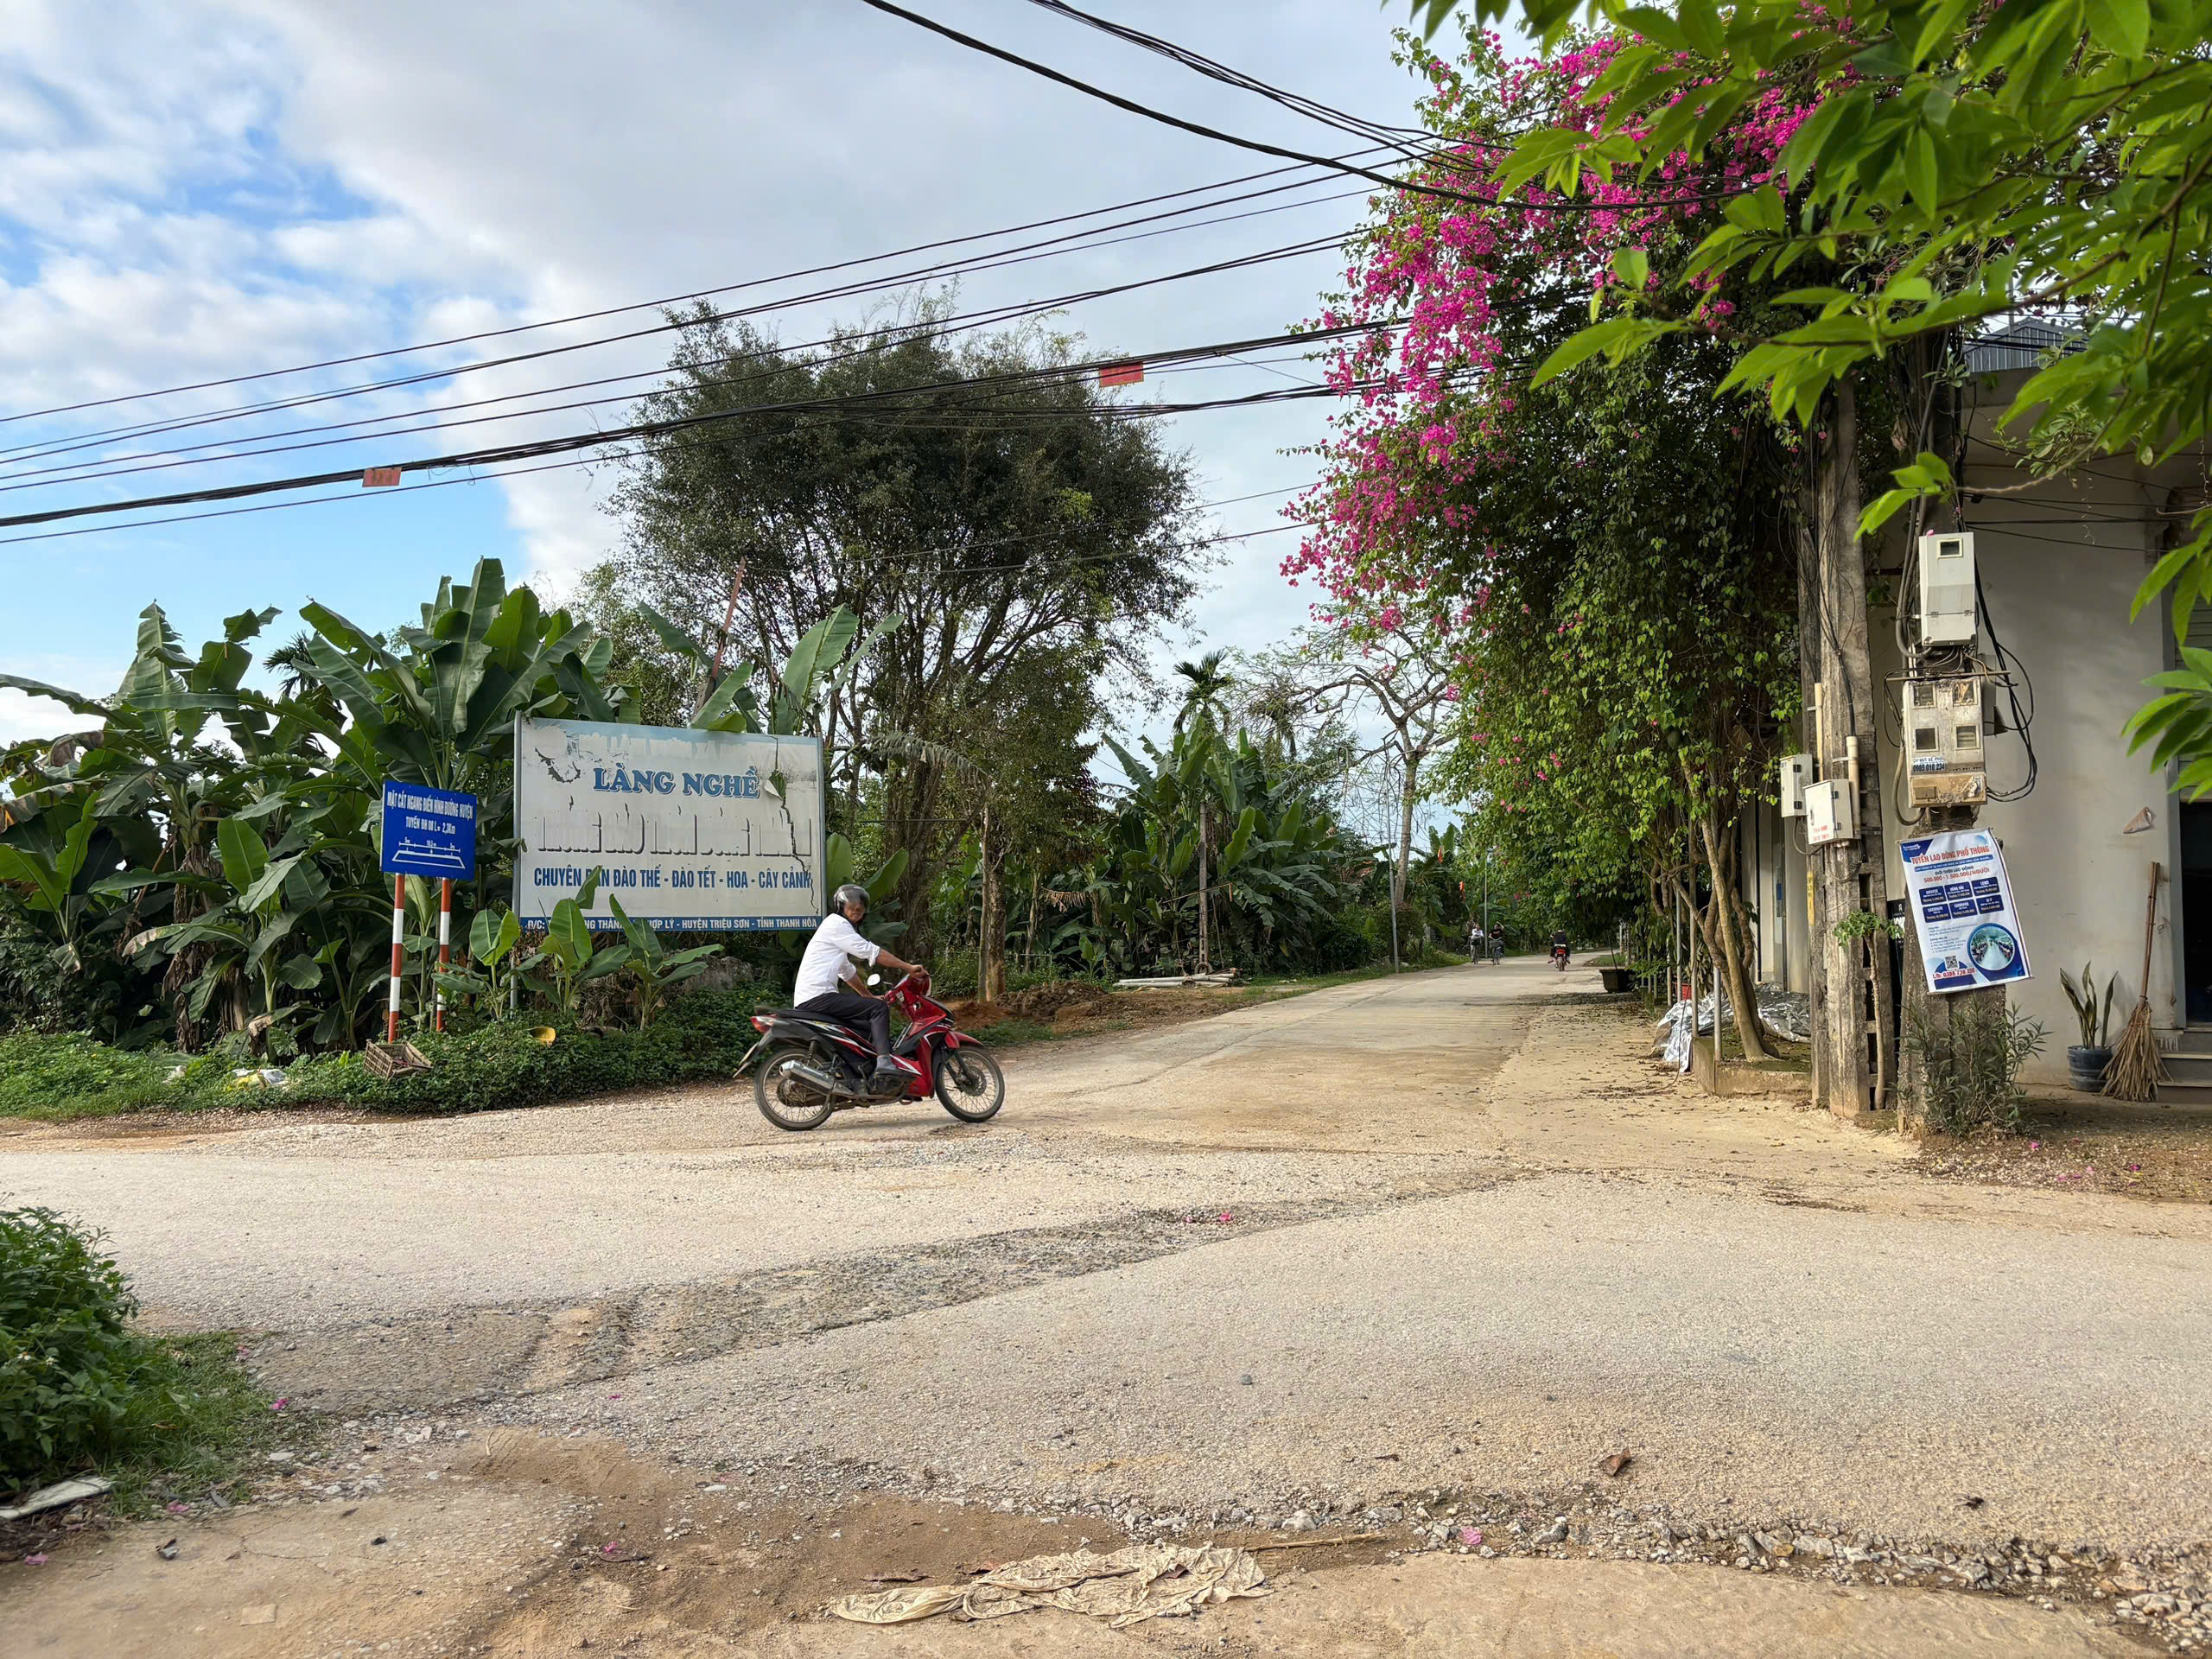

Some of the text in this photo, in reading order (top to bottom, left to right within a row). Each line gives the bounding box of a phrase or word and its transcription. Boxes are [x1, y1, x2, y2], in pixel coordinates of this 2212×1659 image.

[593, 762, 760, 798] LÀNG NGHỀ
[1929, 853, 1941, 861] LAO
[534, 864, 582, 887] CHUYÊN
[613, 866, 637, 887] ĐÀO
[639, 864, 661, 887] THẾ
[671, 867, 694, 888] ĐÀO
[697, 865, 716, 888] TẾT
[727, 871, 748, 888] HOA
[758, 868, 779, 888] CÂY
[782, 866, 811, 888] CẢNH
[598, 918, 622, 930] THÀN
[664, 918, 675, 929] LÝ
[682, 918, 708, 931] HUYỆN
[709, 918, 732, 931] TRIỆU
[734, 918, 750, 929] SƠN
[756, 917, 775, 929] TỈNH
[775, 918, 800, 929] THANH
[802, 917, 817, 929] HÓA
